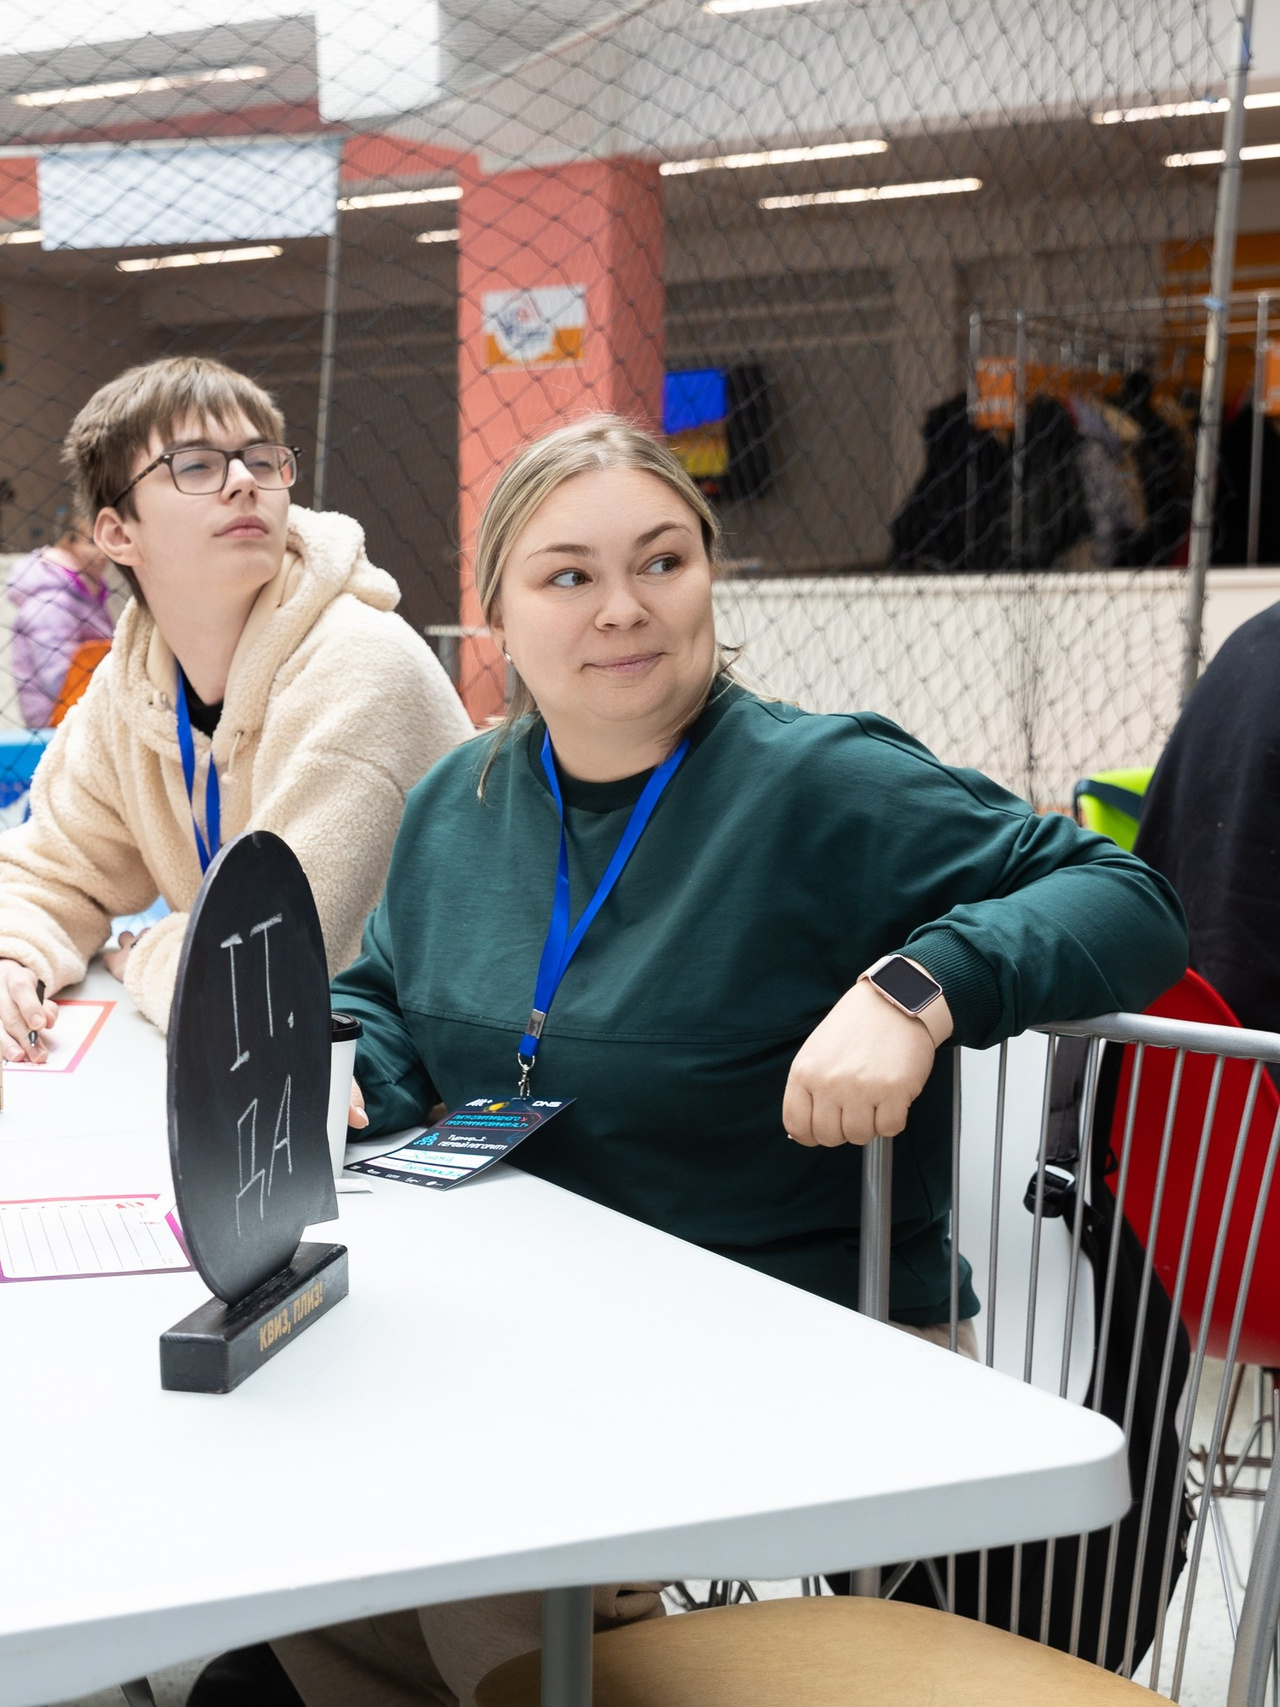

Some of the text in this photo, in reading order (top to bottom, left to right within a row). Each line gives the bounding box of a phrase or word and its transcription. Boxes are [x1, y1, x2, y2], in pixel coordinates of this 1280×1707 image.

[220, 913, 294, 1071] IT.
[235, 1074, 292, 1238] ДА
[531, 1100, 562, 1108] DNS
[259, 1281, 323, 1352] КВИЗ, ПЛИЗ!
